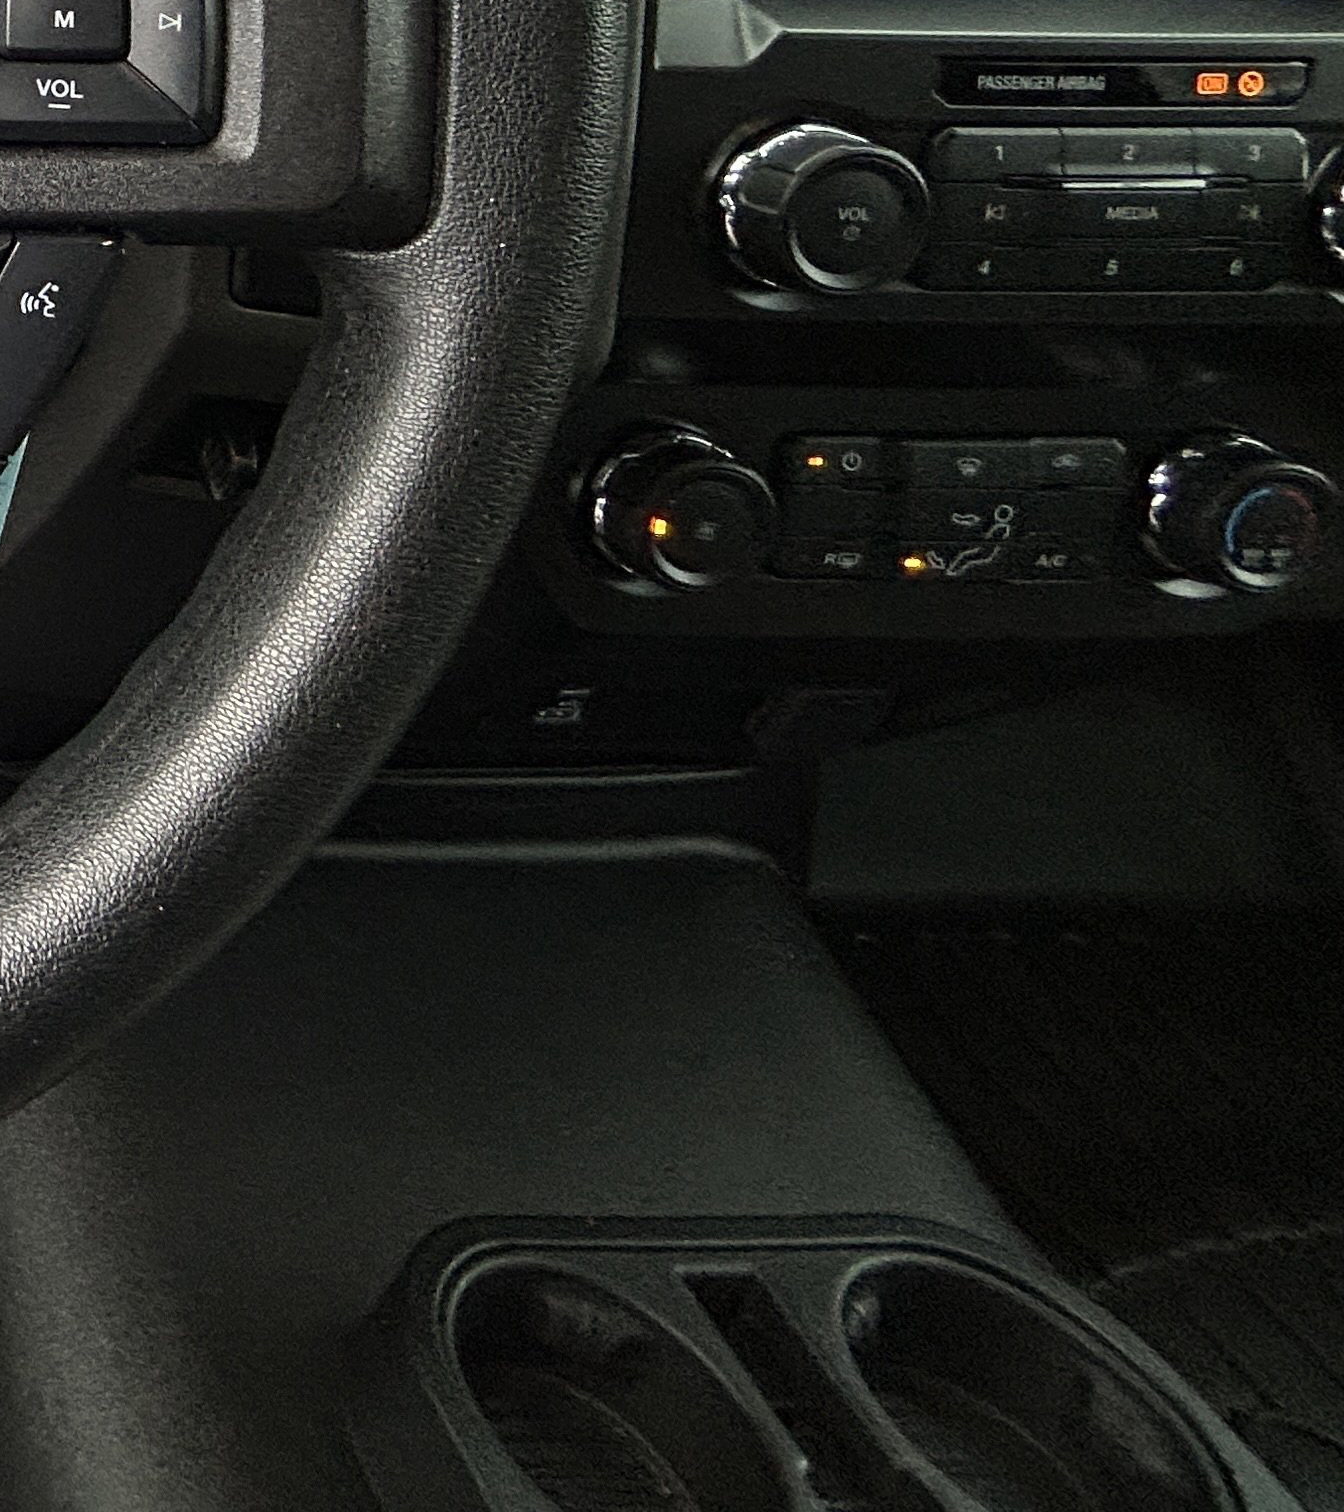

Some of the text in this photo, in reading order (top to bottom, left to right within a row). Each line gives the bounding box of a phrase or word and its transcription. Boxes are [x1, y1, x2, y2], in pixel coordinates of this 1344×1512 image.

[54, 10, 75, 28] M
[36, 78, 84, 100] VOL
[978, 74, 1106, 90] PASSENGER AIRBAG
[995, 145, 1004, 160] 1
[1122, 144, 1135, 160] 2
[838, 206, 870, 221] VOL
